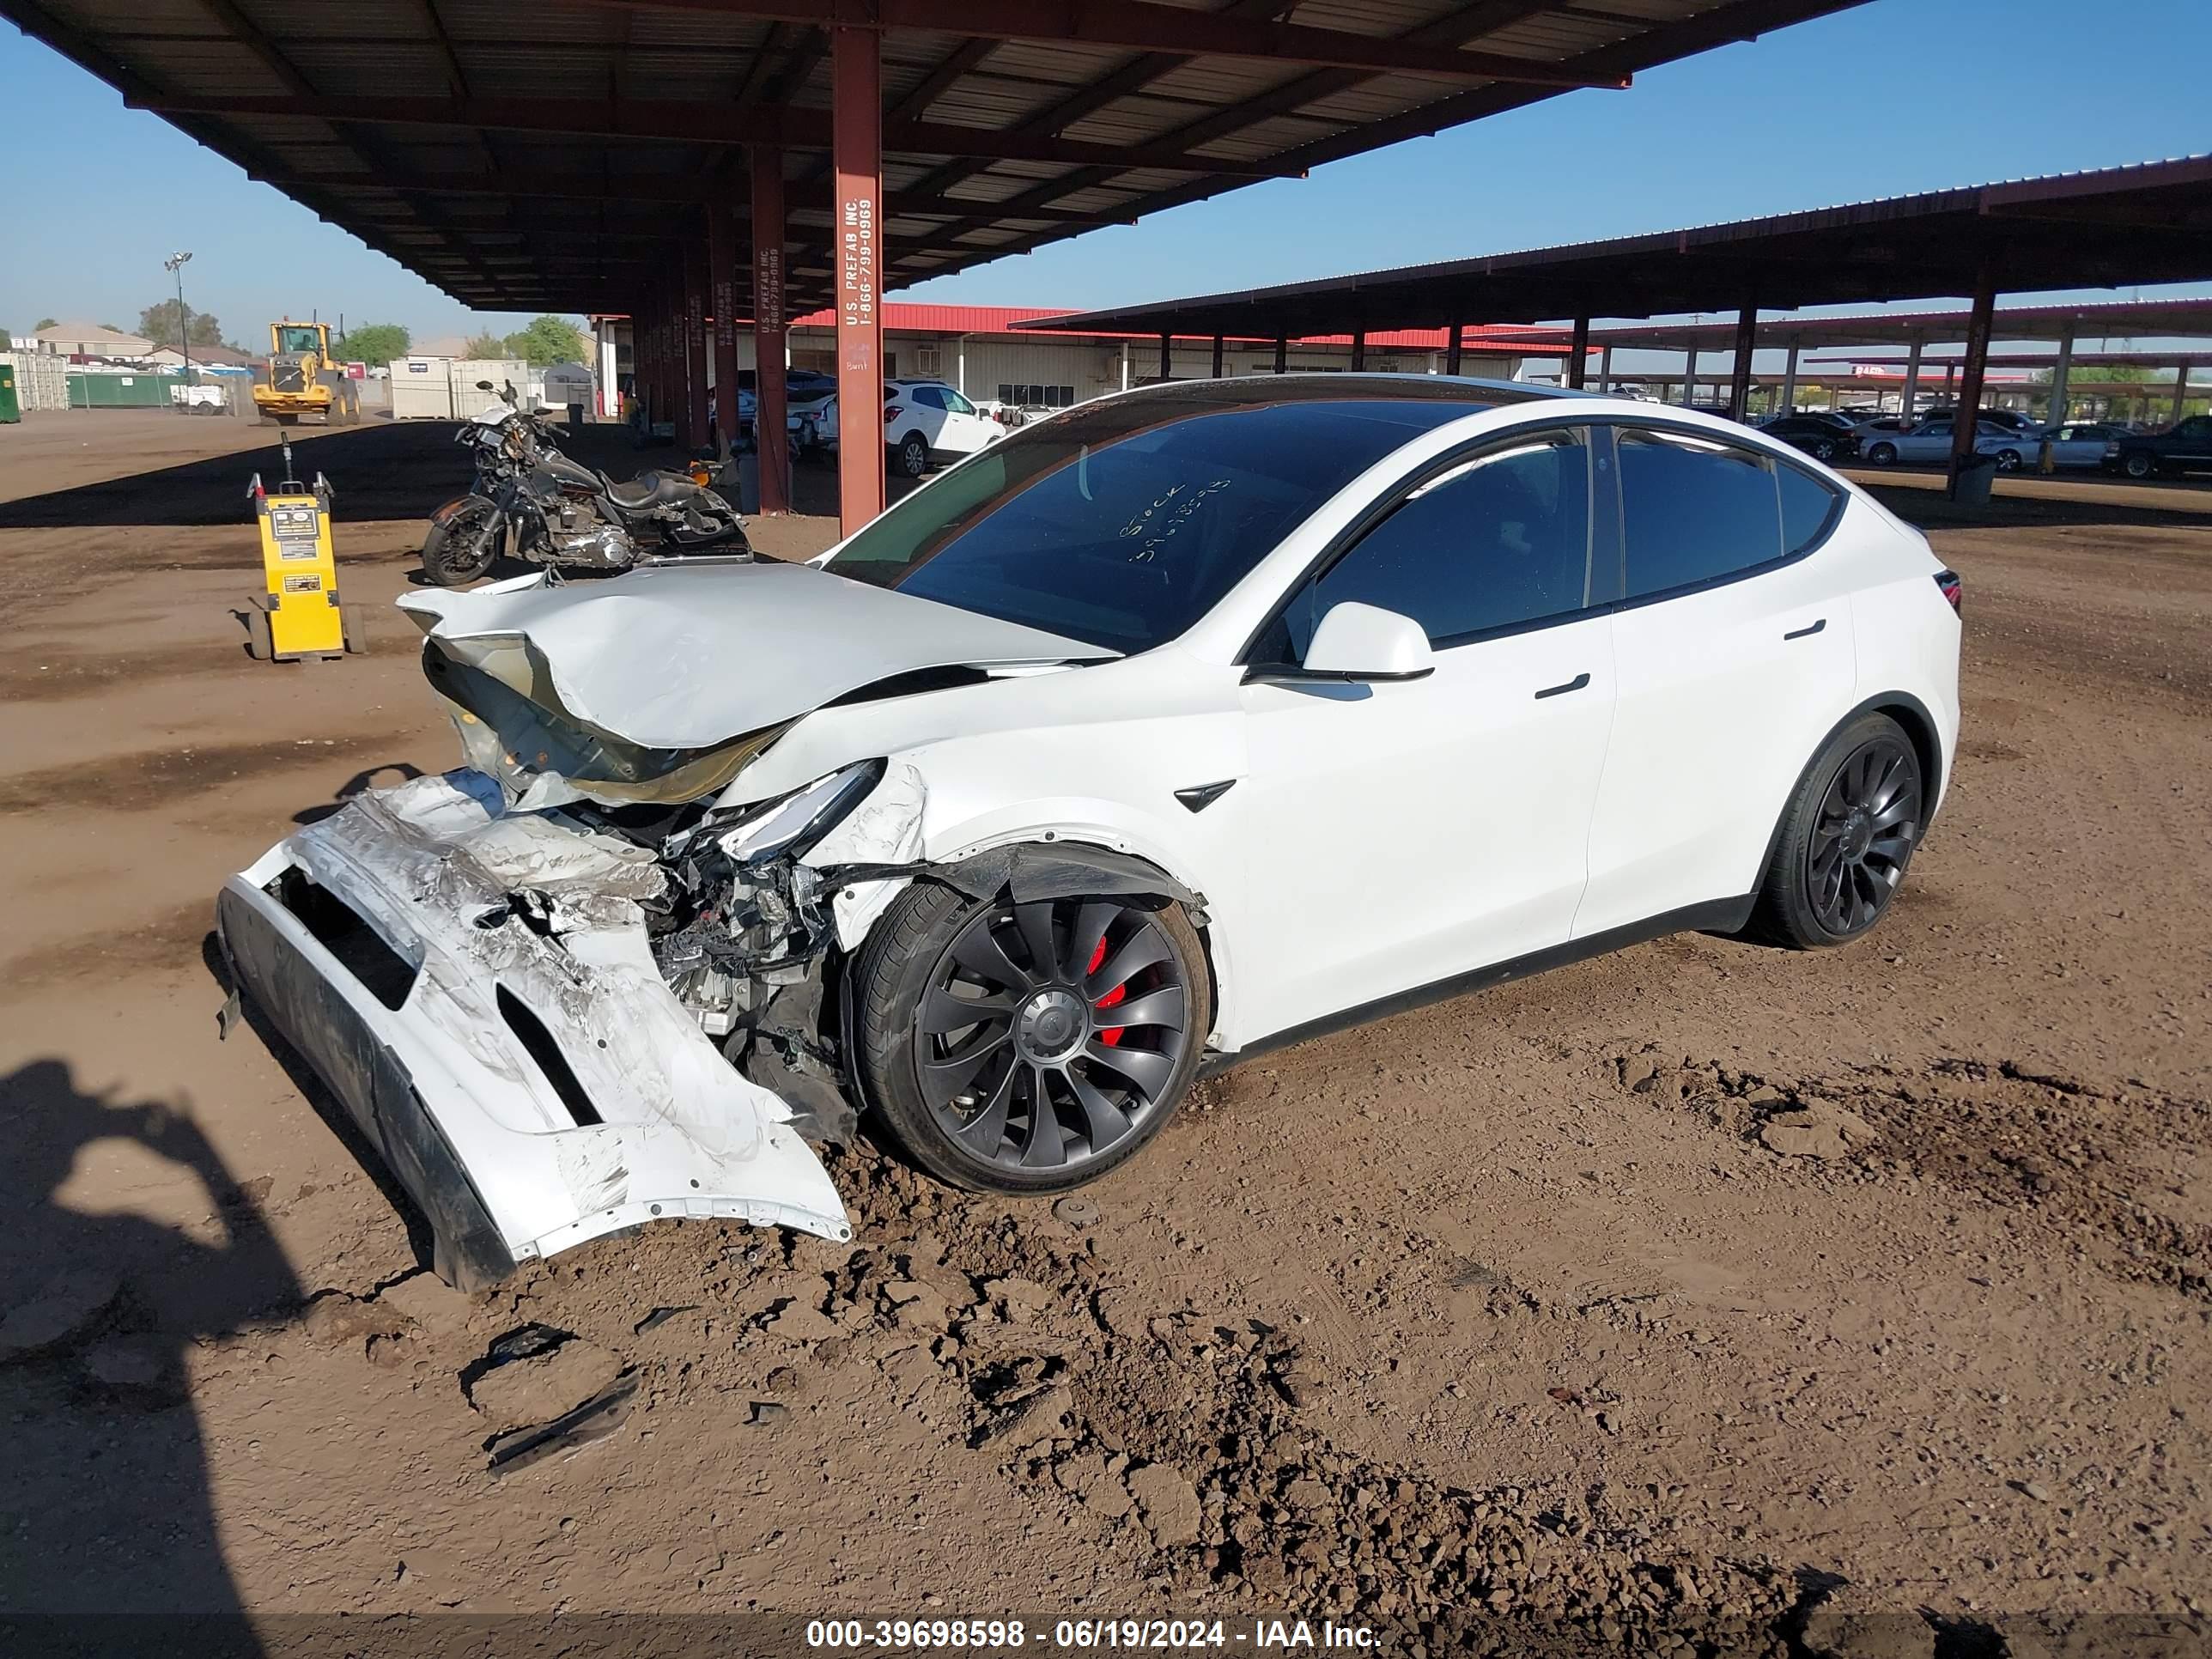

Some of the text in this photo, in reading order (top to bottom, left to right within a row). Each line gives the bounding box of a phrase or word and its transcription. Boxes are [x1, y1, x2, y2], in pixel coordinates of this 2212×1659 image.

[761, 270, 770, 310] PREFAB
[845, 198, 858, 325] U.S. PREFAB INC.
[859, 198, 872, 325] 1-866-799-0969
